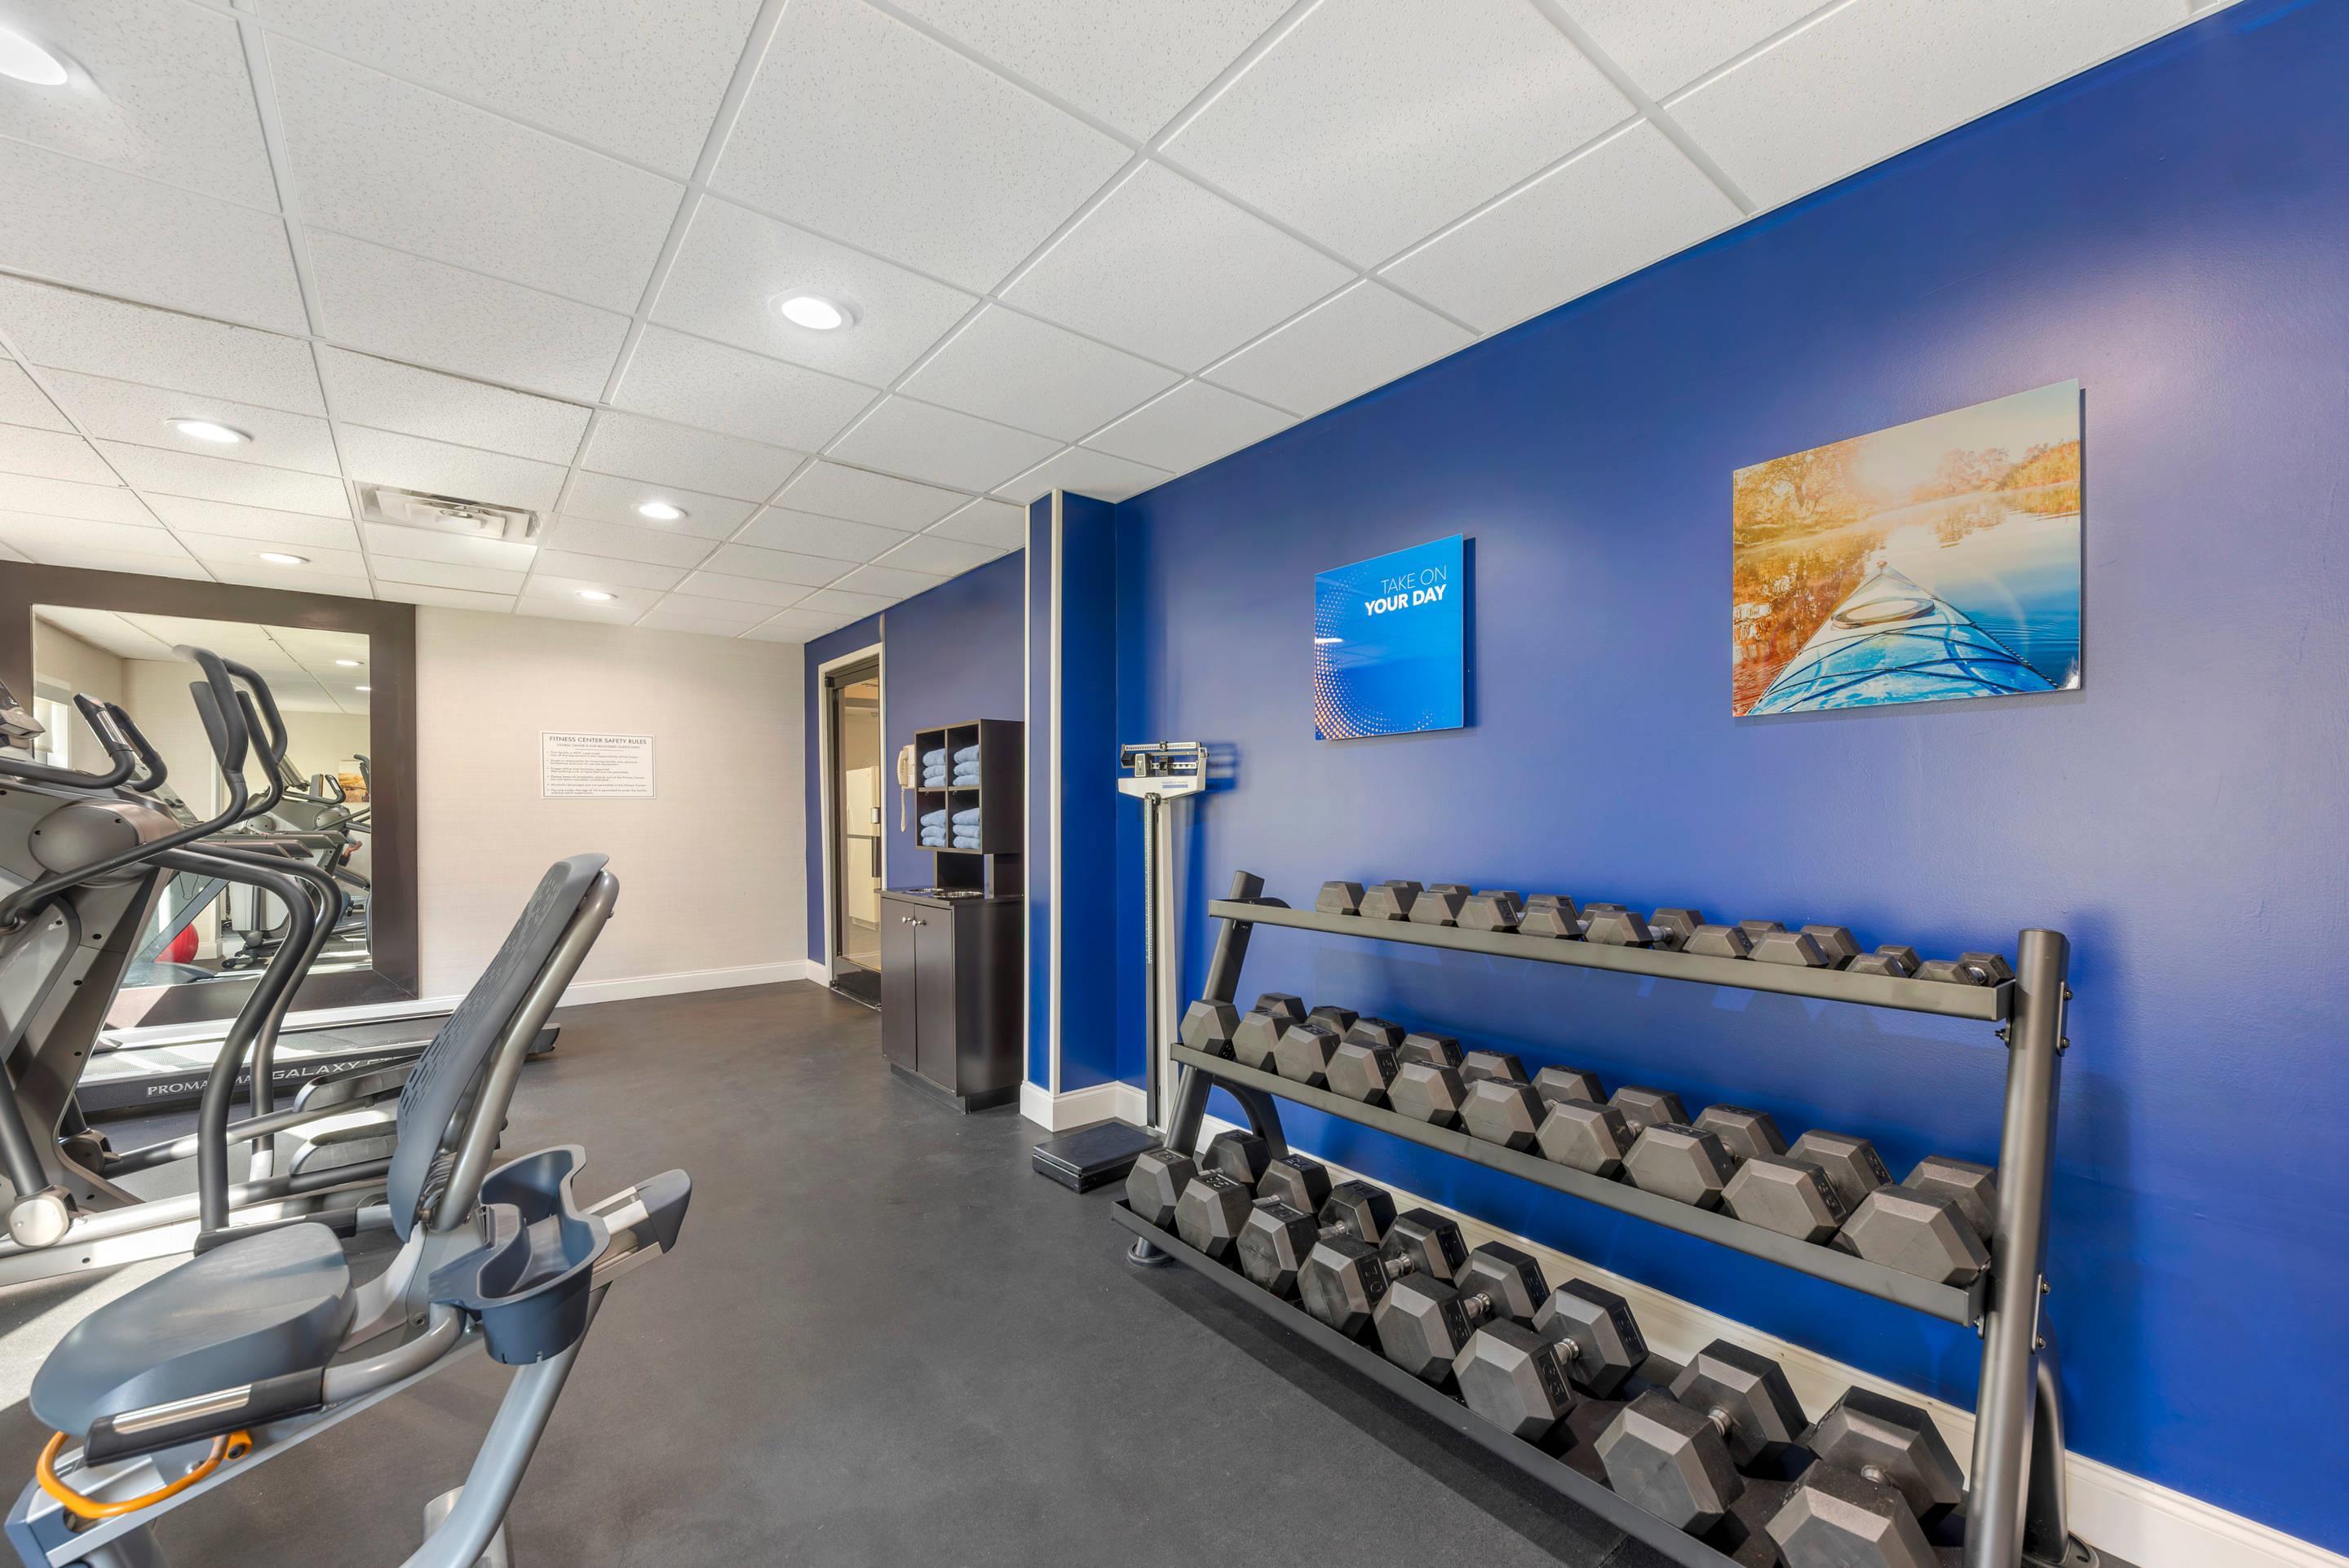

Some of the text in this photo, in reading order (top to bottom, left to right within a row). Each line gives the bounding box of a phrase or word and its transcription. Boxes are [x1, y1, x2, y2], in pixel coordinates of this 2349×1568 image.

[1380, 564, 1447, 594] TAKE ON
[1364, 583, 1448, 616] YOUR DAY
[272, 1061, 360, 1080] GALAXY
